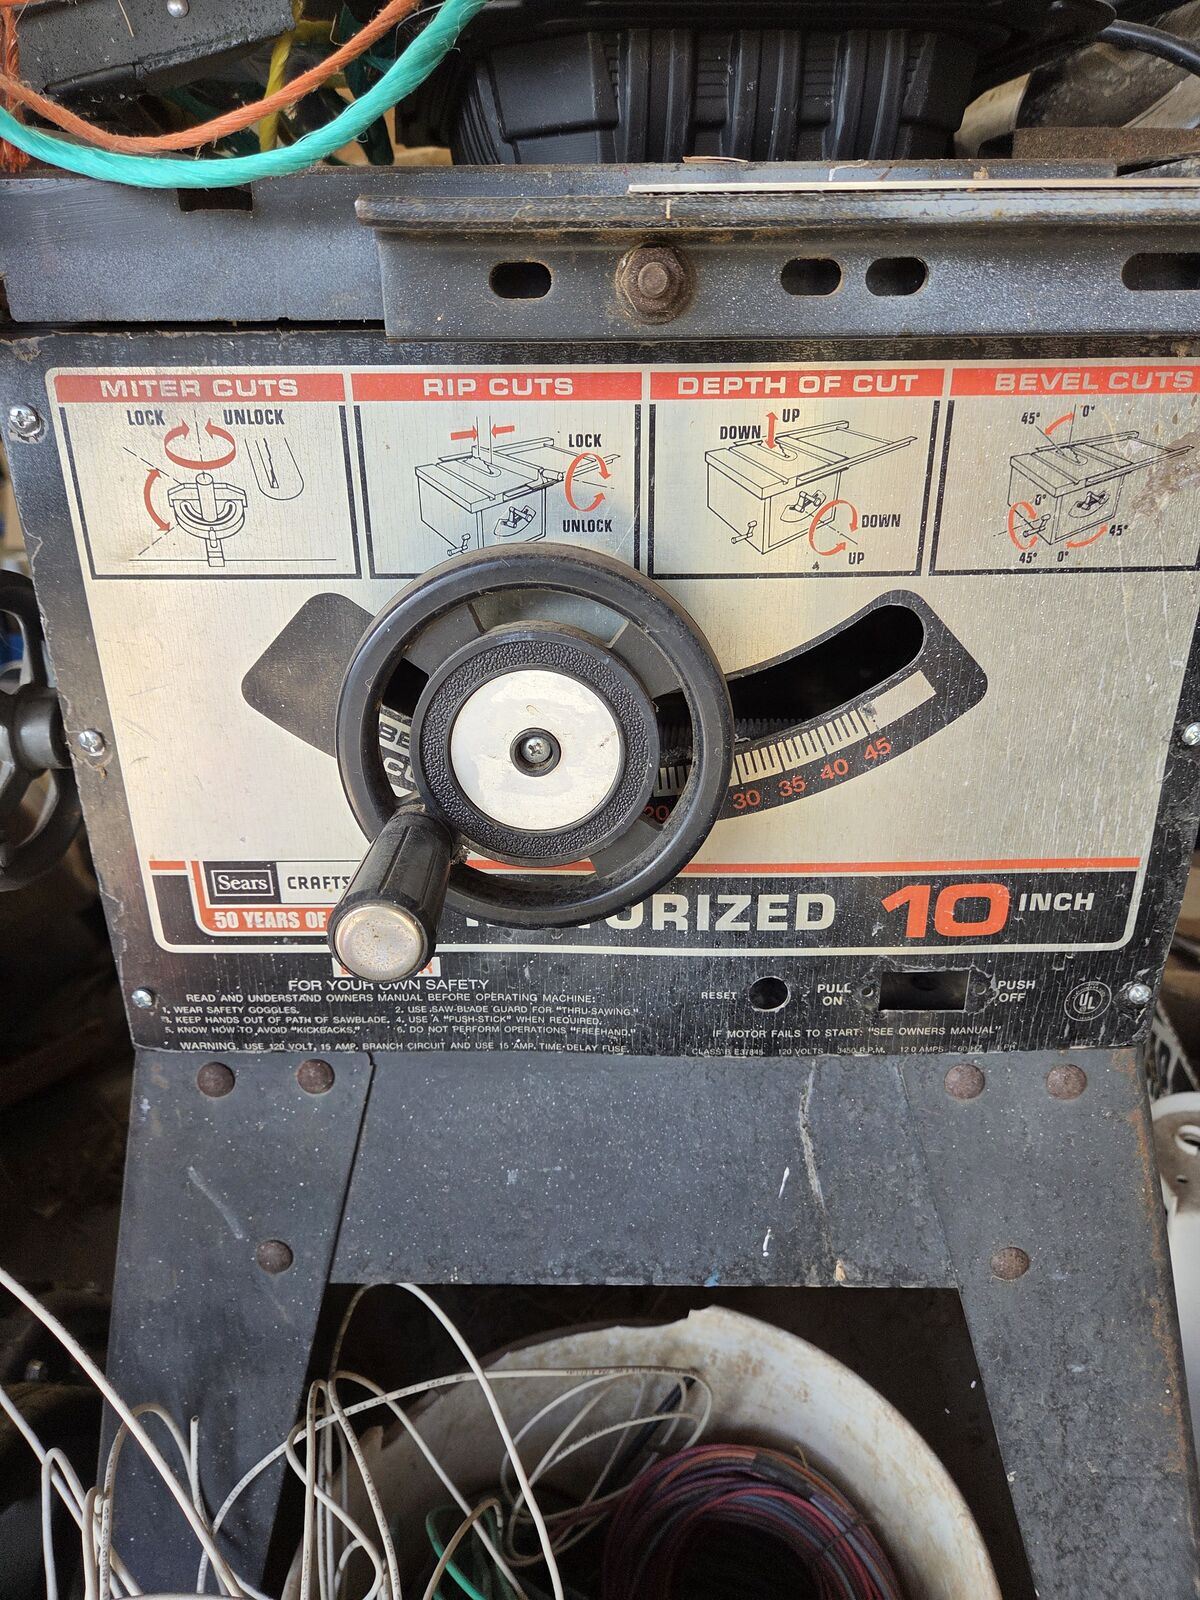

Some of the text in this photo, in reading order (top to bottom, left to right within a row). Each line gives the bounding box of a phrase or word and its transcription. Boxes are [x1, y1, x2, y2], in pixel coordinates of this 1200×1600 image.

[678, 375, 919, 395] DEPTH OF CUT
[996, 371, 1192, 390] BEVEL CUTS
[101, 380, 297, 397] MITER CUTS
[424, 379, 574, 395] RIP CUTS
[128, 410, 165, 425] LOCK
[224, 410, 285, 425] UNLOCK
[782, 409, 800, 422] UP
[1021, 412, 1040, 424] 45°
[720, 426, 761, 440] DOWN
[569, 434, 601, 448] LOCK
[563, 519, 612, 532] UNLOCK
[862, 514, 900, 527] DOWN
[1109, 525, 1128, 536] 45°
[848, 552, 864, 564] UP
[1019, 552, 1037, 564] 45°
[1057, 551, 1069, 562] 0°
[733, 790, 761, 809] 30
[779, 776, 806, 797] 35
[821, 759, 848, 780] 40
[864, 738, 891, 760] 45
[218, 874, 268, 890] Sears
[288, 876, 350, 889] CRAFTS
[881, 883, 1009, 937] 10
[1019, 893, 1094, 911] INCH
[214, 912, 326, 928] 50 YEARS OF
[288, 980, 489, 991] FOR YOUR OWN SAFETY
[818, 984, 851, 993] PULL
[998, 981, 1035, 990] PUSH
[186, 994, 215, 1002] READ
[221, 994, 243, 1002] AND
[248, 994, 321, 1002] UNDERSTAND
[326, 994, 373, 1002] OWNERS
[378, 994, 423, 1002] MANUAL
[476, 993, 537, 1002] OPERATING
[701, 992, 737, 1000] RESET
[823, 997, 842, 1006] ON
[999, 993, 1025, 1002] OFF
[173, 1006, 203, 1014] WEAR
[175, 1016, 201, 1024] KEEP
[205, 1016, 239, 1024] HANDS
[333, 1016, 390, 1024] SAWBLADE.
[177, 1026, 208, 1034] KNOW
[713, 1030, 721, 1038] IF
[727, 1030, 766, 1038] MOTOR
[772, 1029, 800, 1037] FAILS
[806, 1029, 820, 1037] TO
[869, 1028, 893, 1036] "SEE
[899, 1027, 946, 1036] OWNERS
[951, 1026, 1001, 1034] MANUAL"
[363, 1042, 402, 1050] BRANCH
[408, 1042, 445, 1050] CIRCUIT
[475, 1042, 494, 1050] USE
